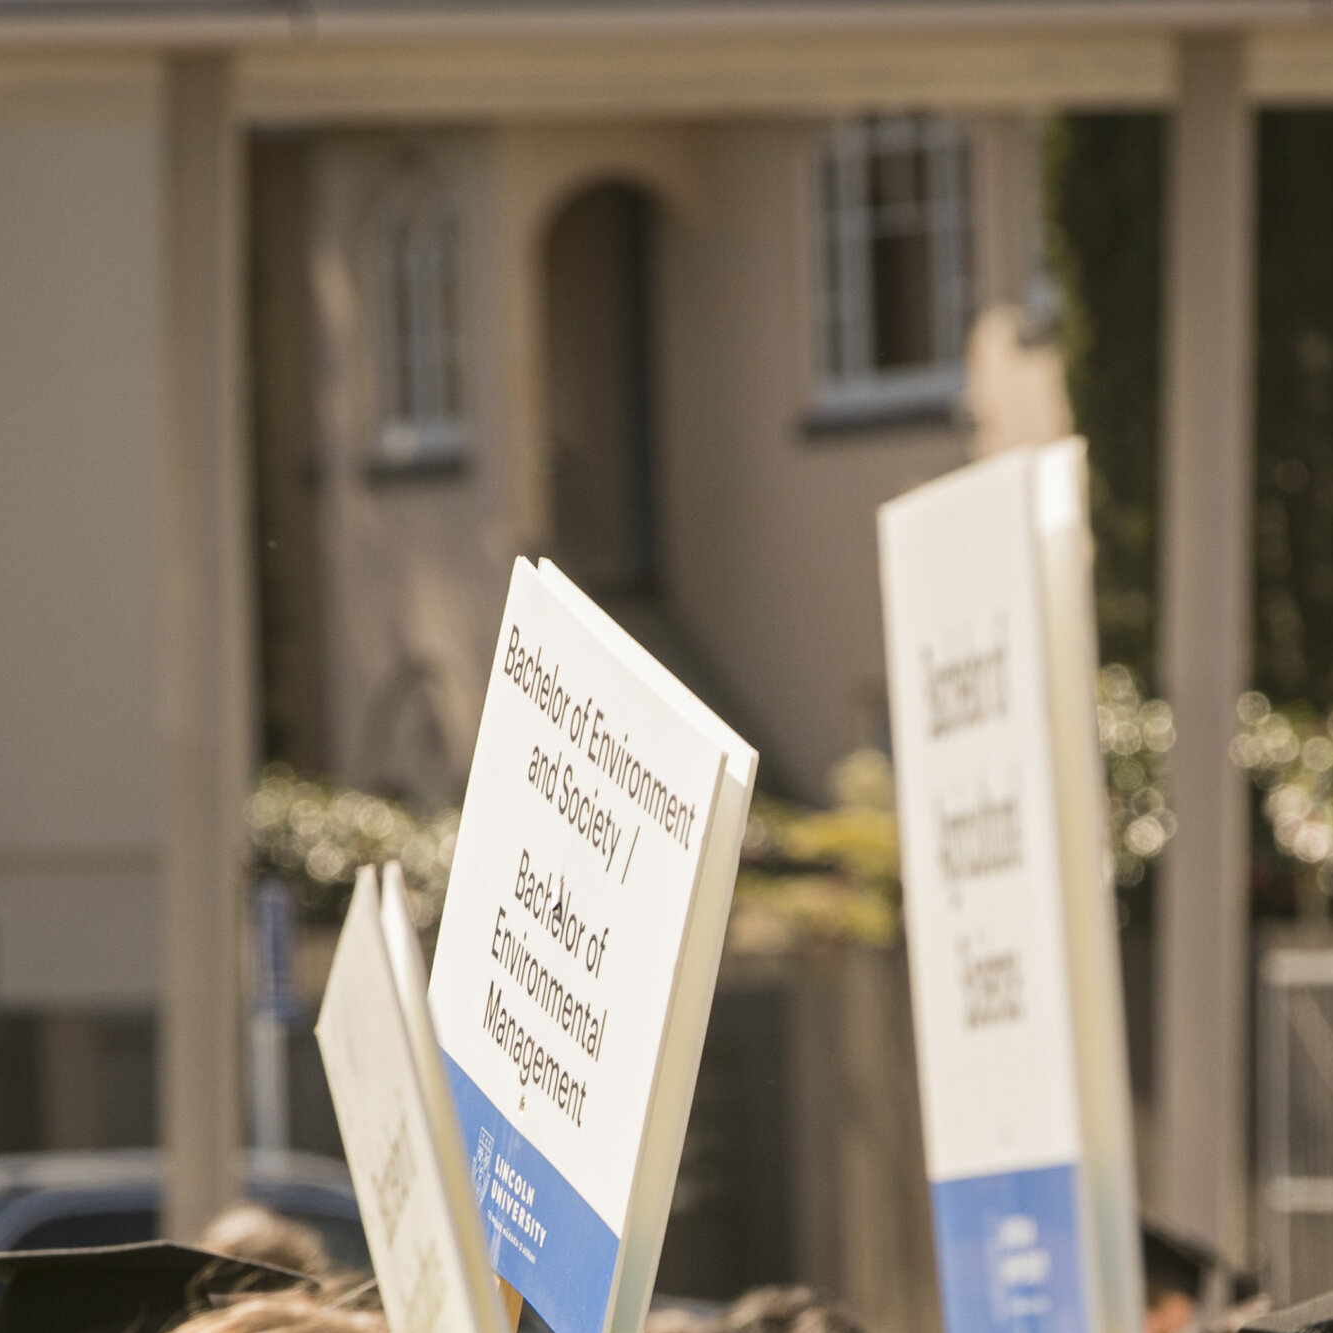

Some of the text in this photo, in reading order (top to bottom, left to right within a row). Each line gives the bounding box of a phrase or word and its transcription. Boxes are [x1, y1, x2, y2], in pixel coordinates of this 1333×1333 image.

[504, 624, 695, 851] Bachelor of Environment
[528, 744, 562, 805] and
[559, 763, 621, 873] Society
[514, 848, 609, 979] Bachelor of
[491, 906, 608, 1062] Environmental
[483, 979, 586, 1128] Management
[490, 1178, 547, 1249] UNIVERSITY
[494, 1153, 535, 1208] LINCOLN
